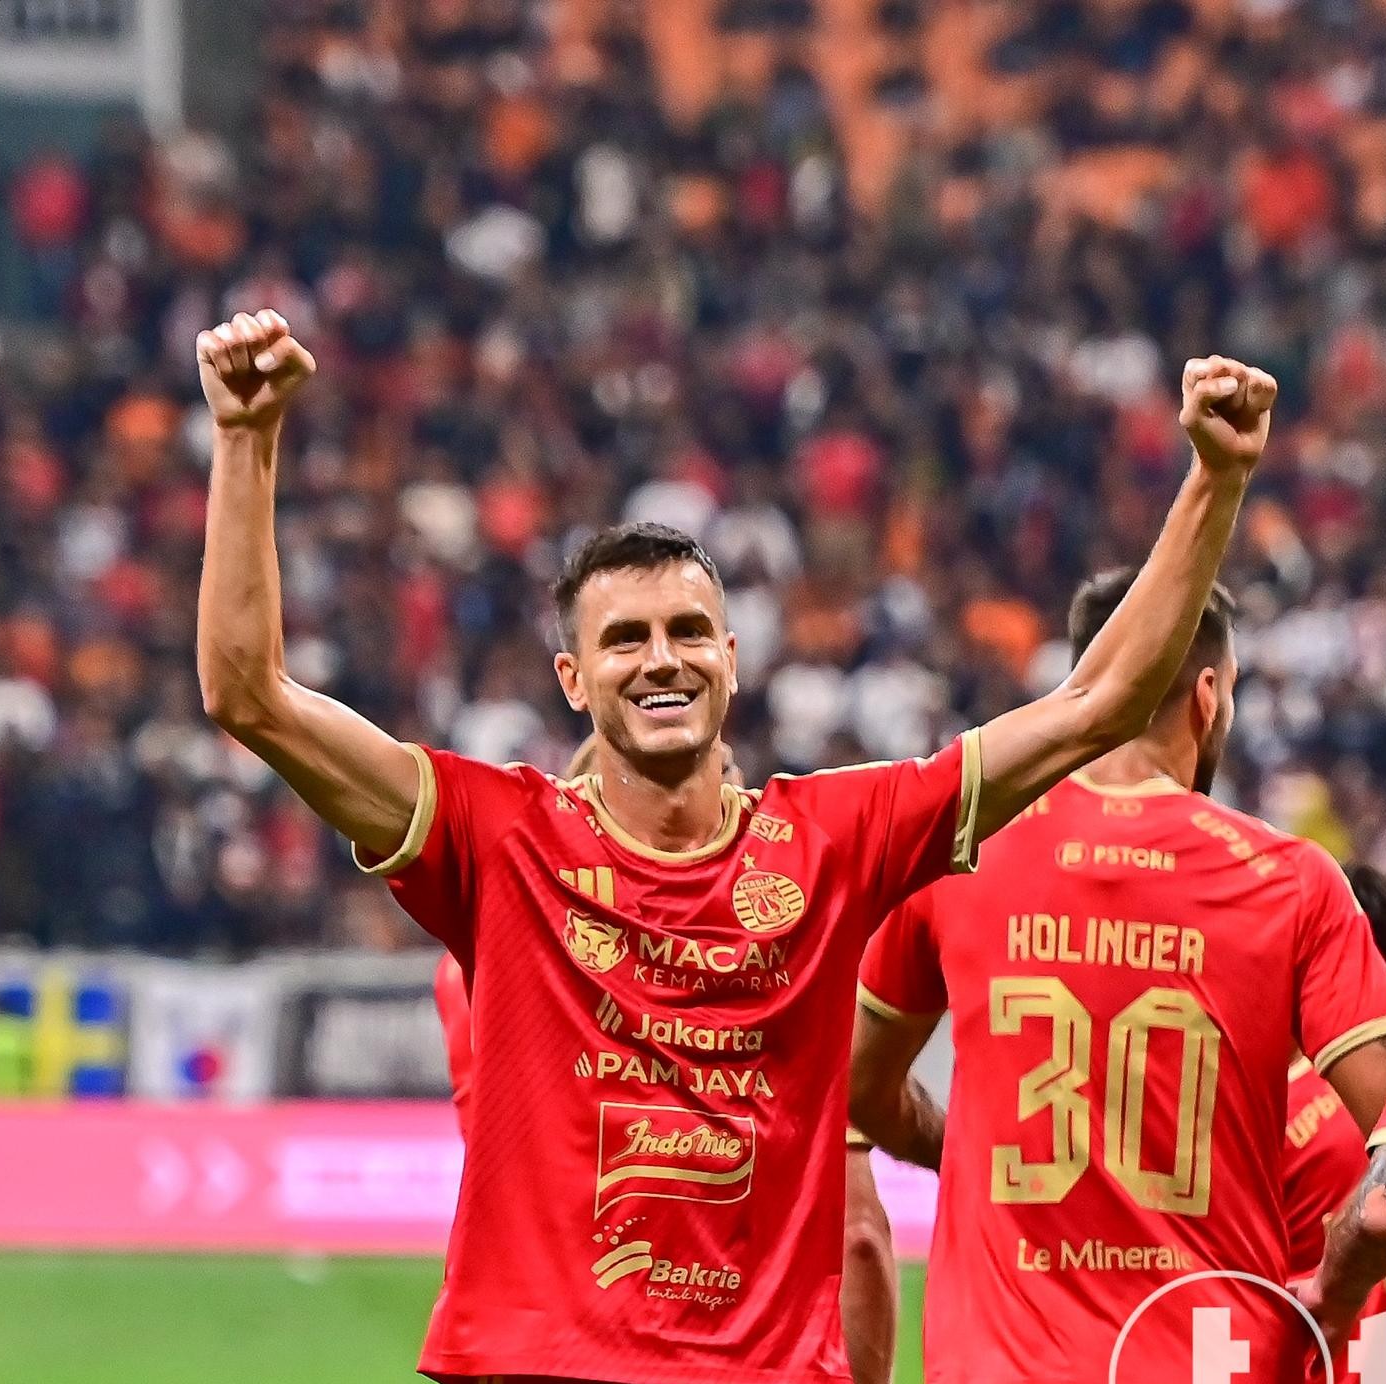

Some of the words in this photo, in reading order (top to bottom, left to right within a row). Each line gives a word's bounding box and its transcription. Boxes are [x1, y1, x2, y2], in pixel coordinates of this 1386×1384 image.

[1094, 845, 1176, 873] PSTORE
[639, 933, 790, 973] MACAN
[1007, 914, 1205, 976] HOLINGER
[632, 1013, 763, 1051] Jakarta
[597, 1052, 678, 1086] PAM
[689, 1068, 774, 1098] JAYA
[989, 976, 1221, 1218] 30
[1017, 1238, 1051, 1271] Le
[649, 1260, 741, 1289] Bakrie
